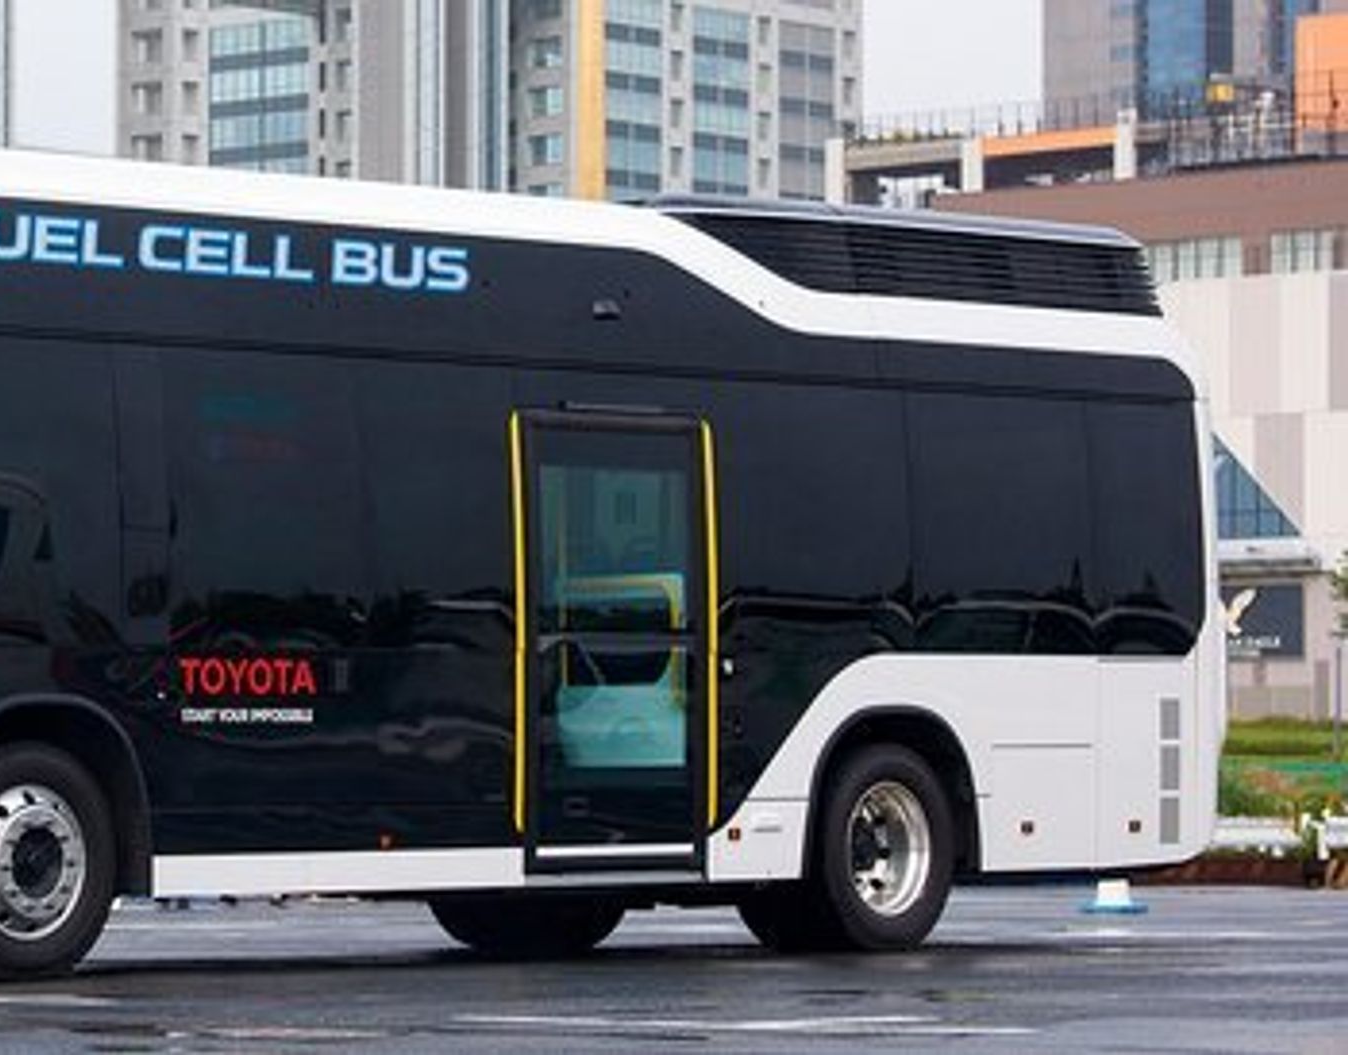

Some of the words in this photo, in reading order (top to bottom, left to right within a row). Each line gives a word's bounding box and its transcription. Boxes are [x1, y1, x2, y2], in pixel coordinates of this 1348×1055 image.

[137, 225, 314, 282] CELL
[331, 239, 470, 292] BUS
[180, 658, 317, 695] TOYOTA
